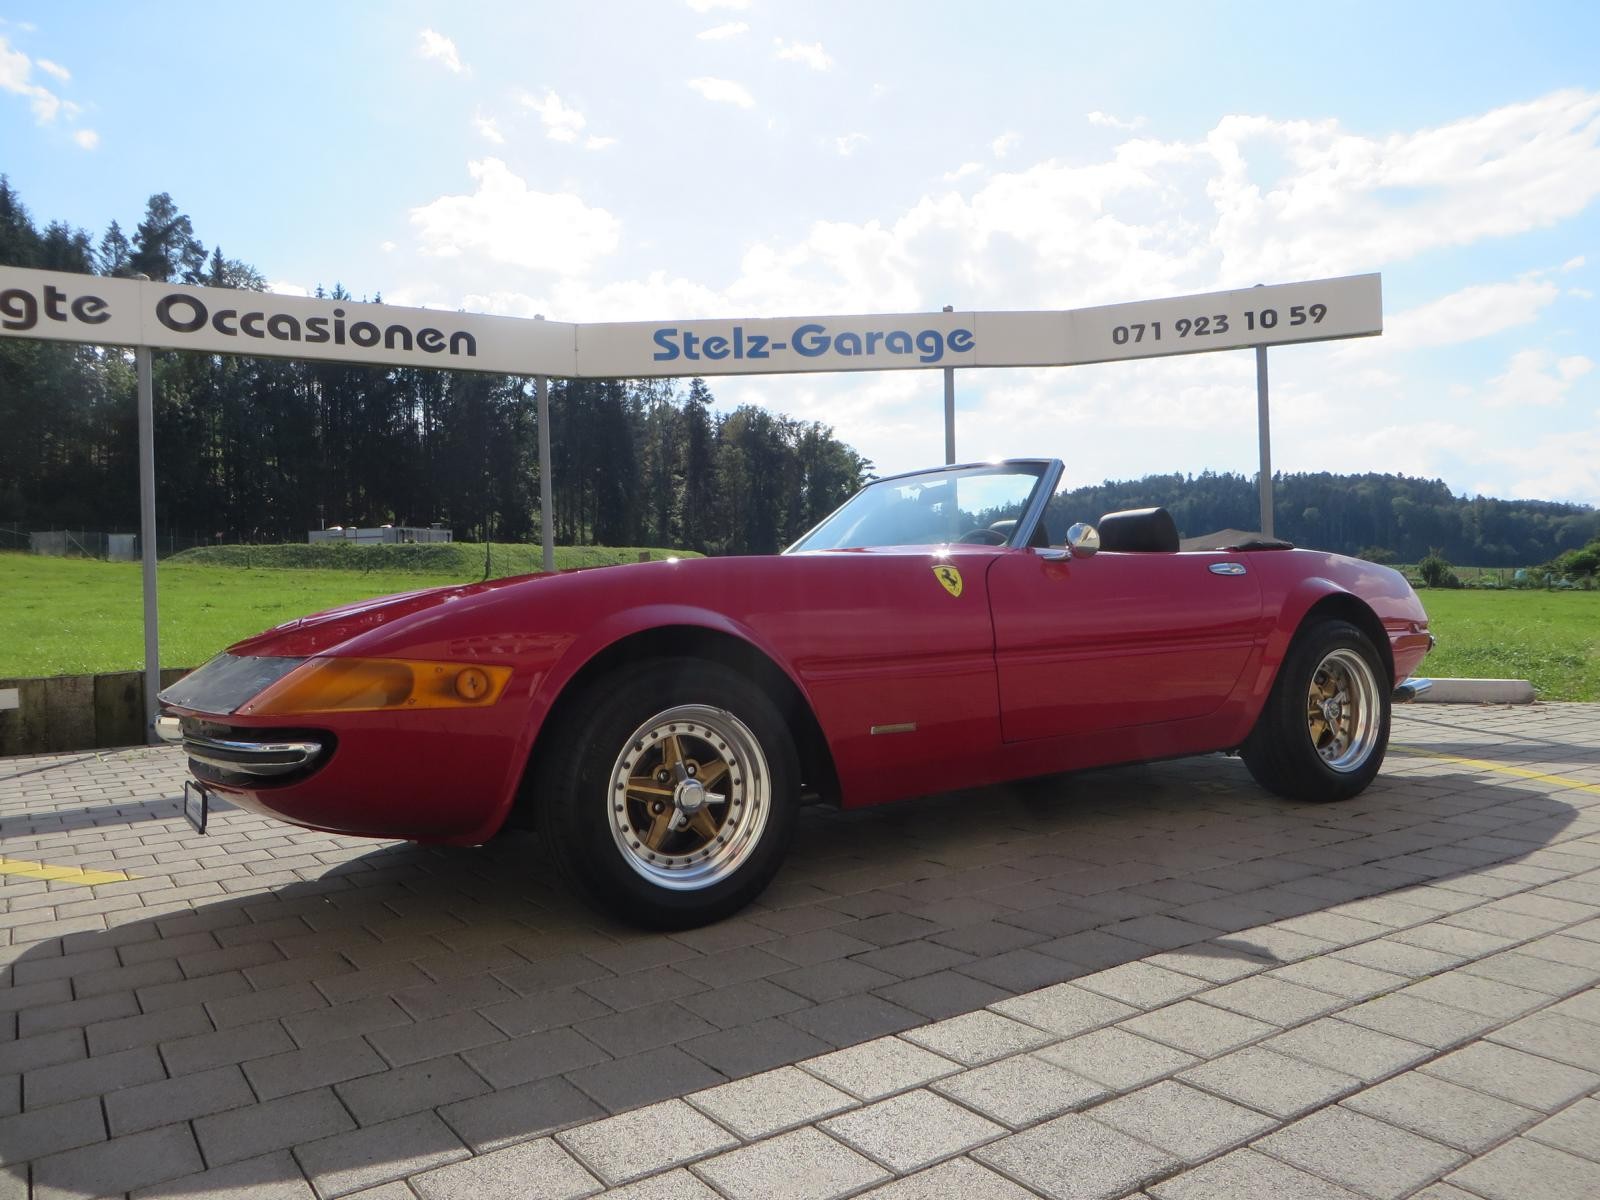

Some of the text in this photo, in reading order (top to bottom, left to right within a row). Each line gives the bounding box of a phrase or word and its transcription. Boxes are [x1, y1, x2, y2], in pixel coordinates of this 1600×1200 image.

[155, 293, 477, 357] Occasionen
[653, 324, 976, 363] Stelz-Garage
[1112, 303, 1328, 345] 071 923 10 59
